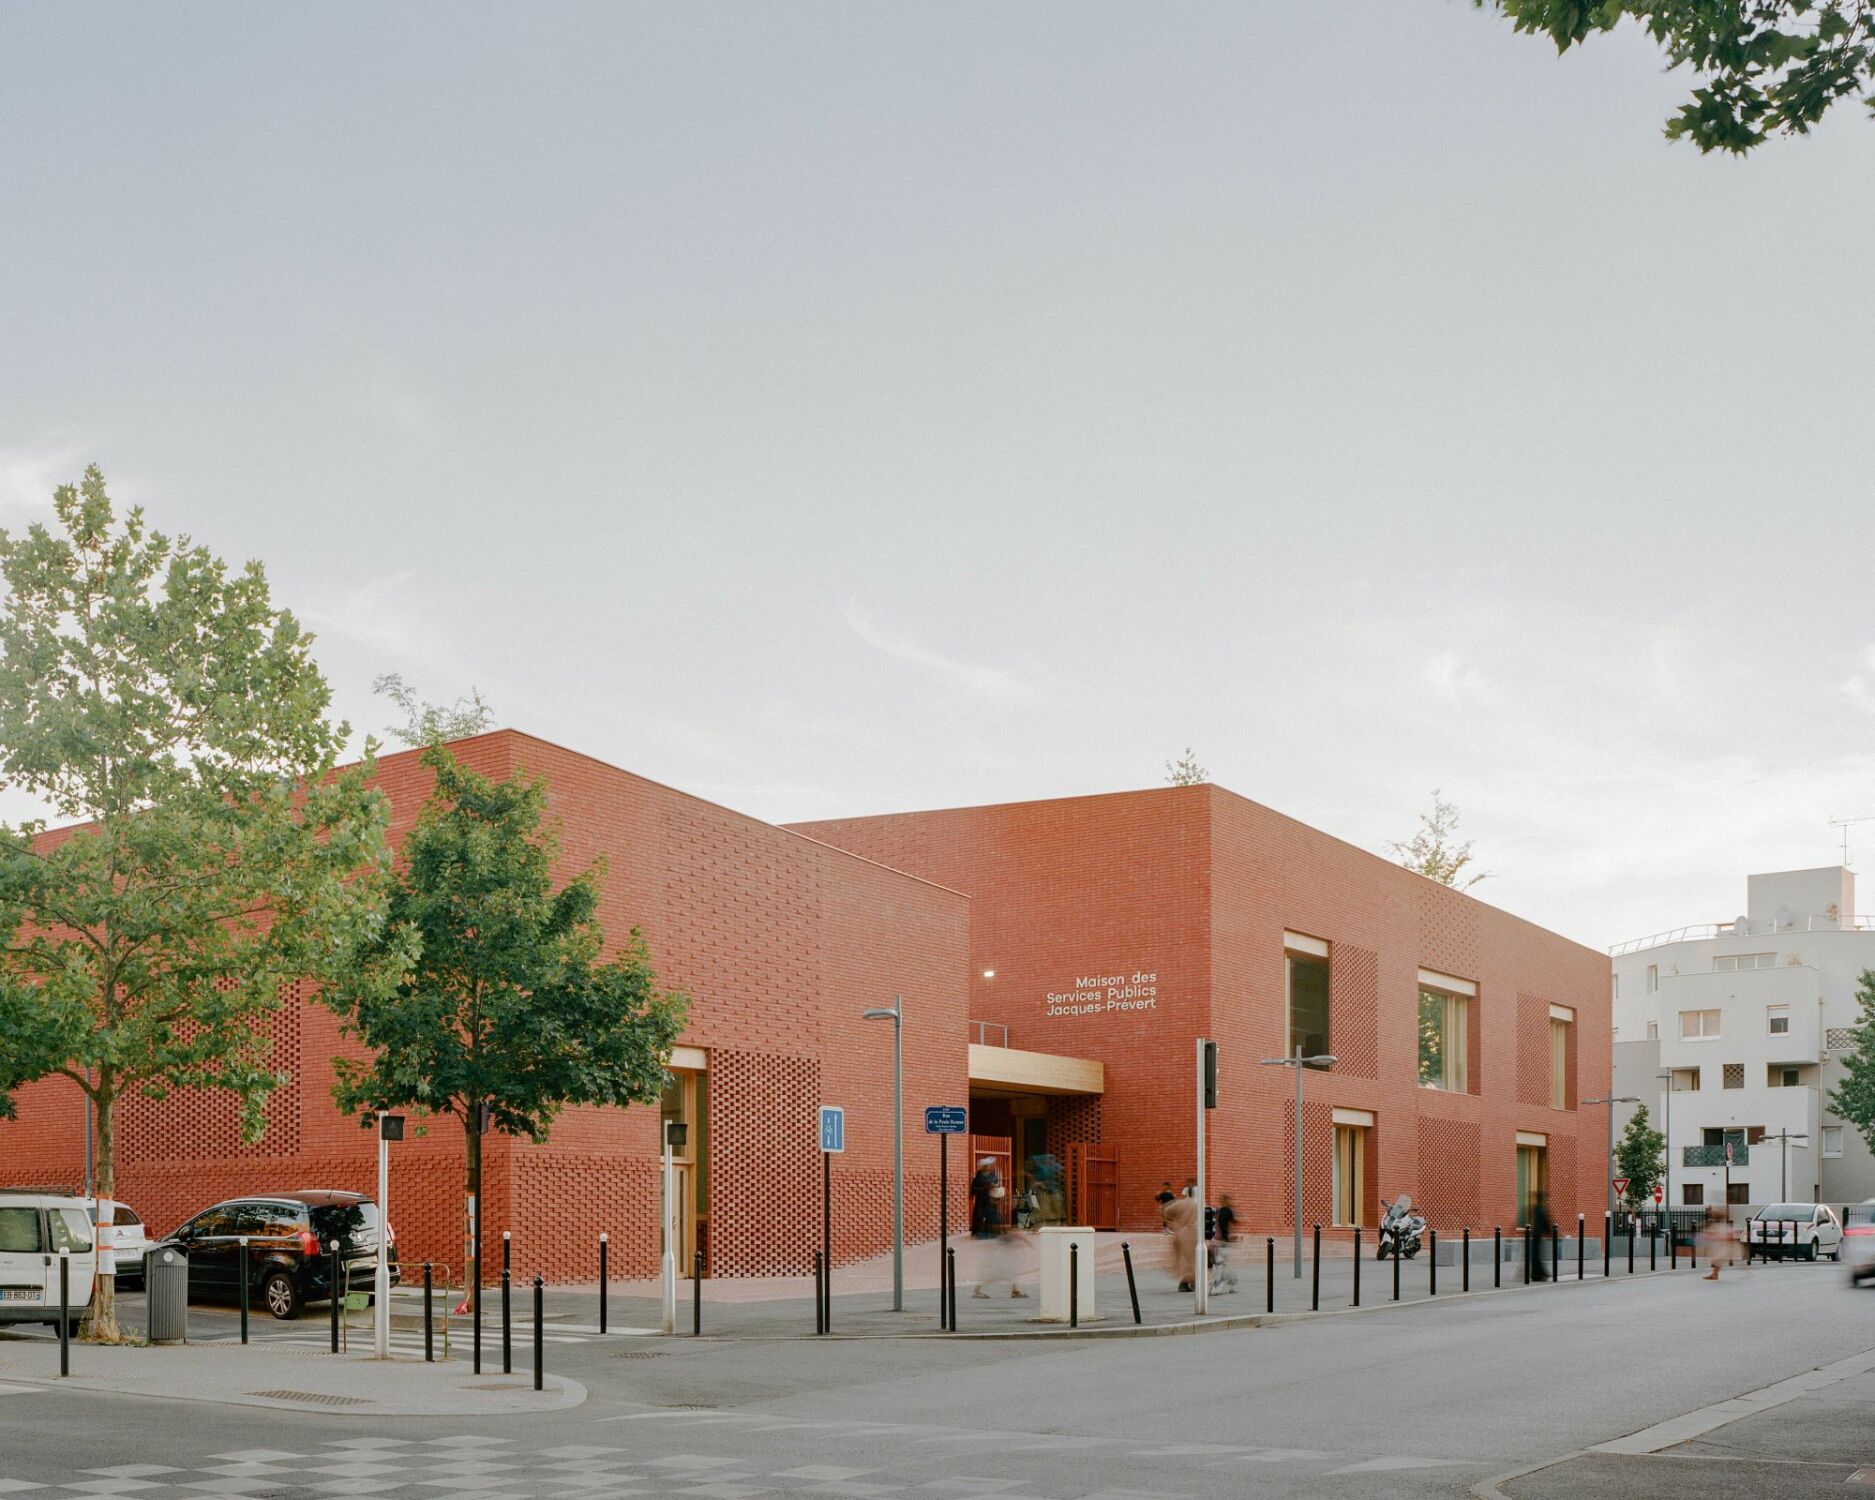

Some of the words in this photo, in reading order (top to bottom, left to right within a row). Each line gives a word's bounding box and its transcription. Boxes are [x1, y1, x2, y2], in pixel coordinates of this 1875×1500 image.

[1076, 975, 1125, 988] Maison
[1132, 971, 1157, 984] des
[1047, 990, 1101, 1004] Services
[1108, 985, 1157, 999] Publics
[1046, 998, 1157, 1016] Jacques-Prévert
